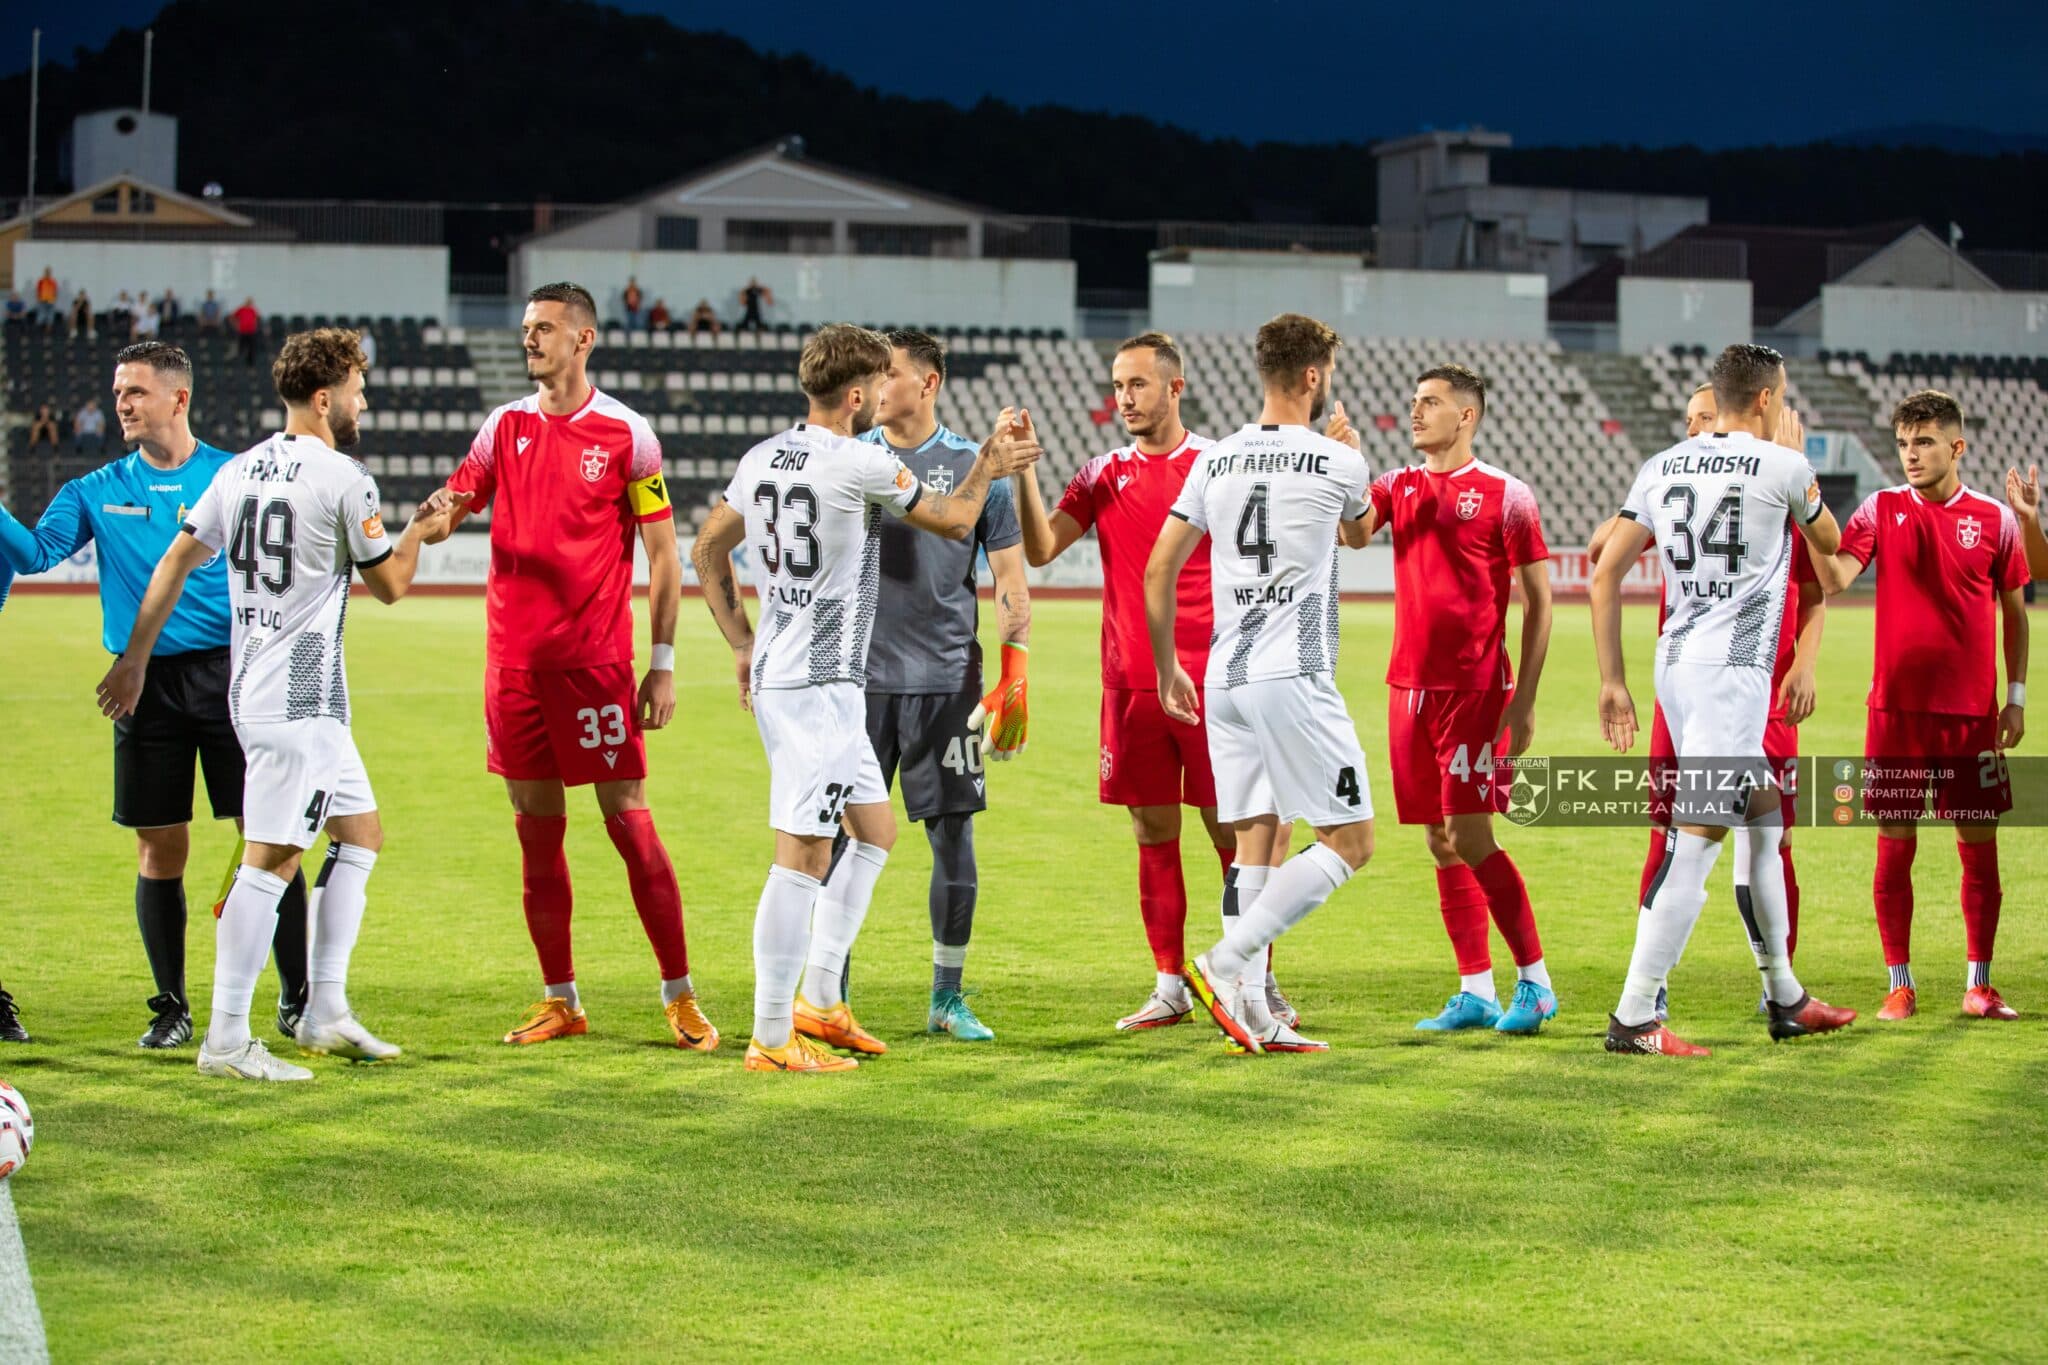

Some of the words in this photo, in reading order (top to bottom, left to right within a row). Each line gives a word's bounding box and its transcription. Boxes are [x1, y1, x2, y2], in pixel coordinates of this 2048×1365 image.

[1662, 456, 1760, 476] VELKOSKI
[149, 484, 182, 492] uhlsport
[229, 495, 297, 598] 49
[753, 480, 822, 581] 33
[1234, 481, 1277, 577] 4
[1661, 483, 1748, 576] 34
[1234, 588, 1254, 605] KF
[1695, 581, 1733, 601] LAÇI
[577, 703, 627, 749] 33
[941, 734, 984, 776] 40
[1448, 742, 1494, 783] 44
[1336, 766, 1362, 806] 4
